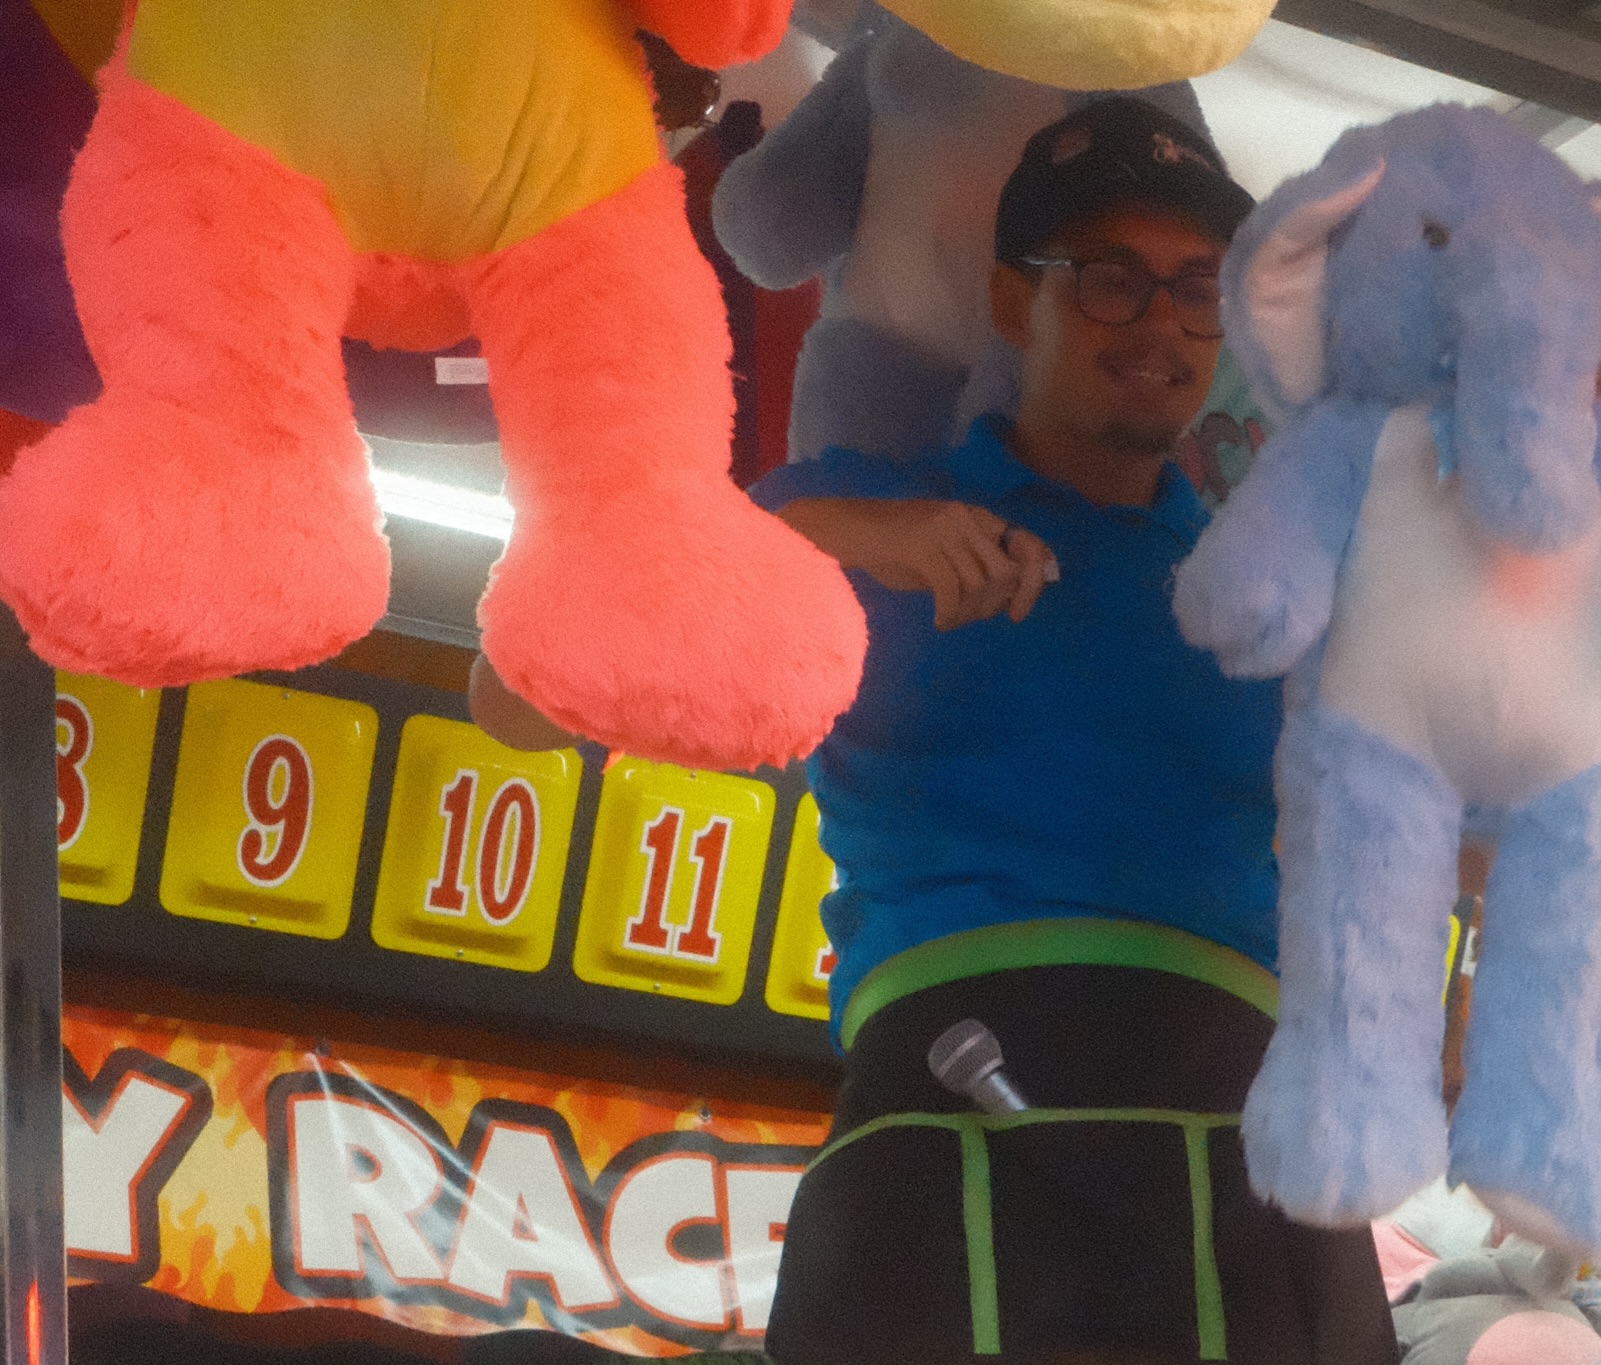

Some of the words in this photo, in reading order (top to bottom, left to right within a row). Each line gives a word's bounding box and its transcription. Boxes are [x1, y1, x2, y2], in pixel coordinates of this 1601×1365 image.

[237, 734, 314, 887] 9
[425, 769, 540, 925] 10
[623, 806, 731, 962] 11
